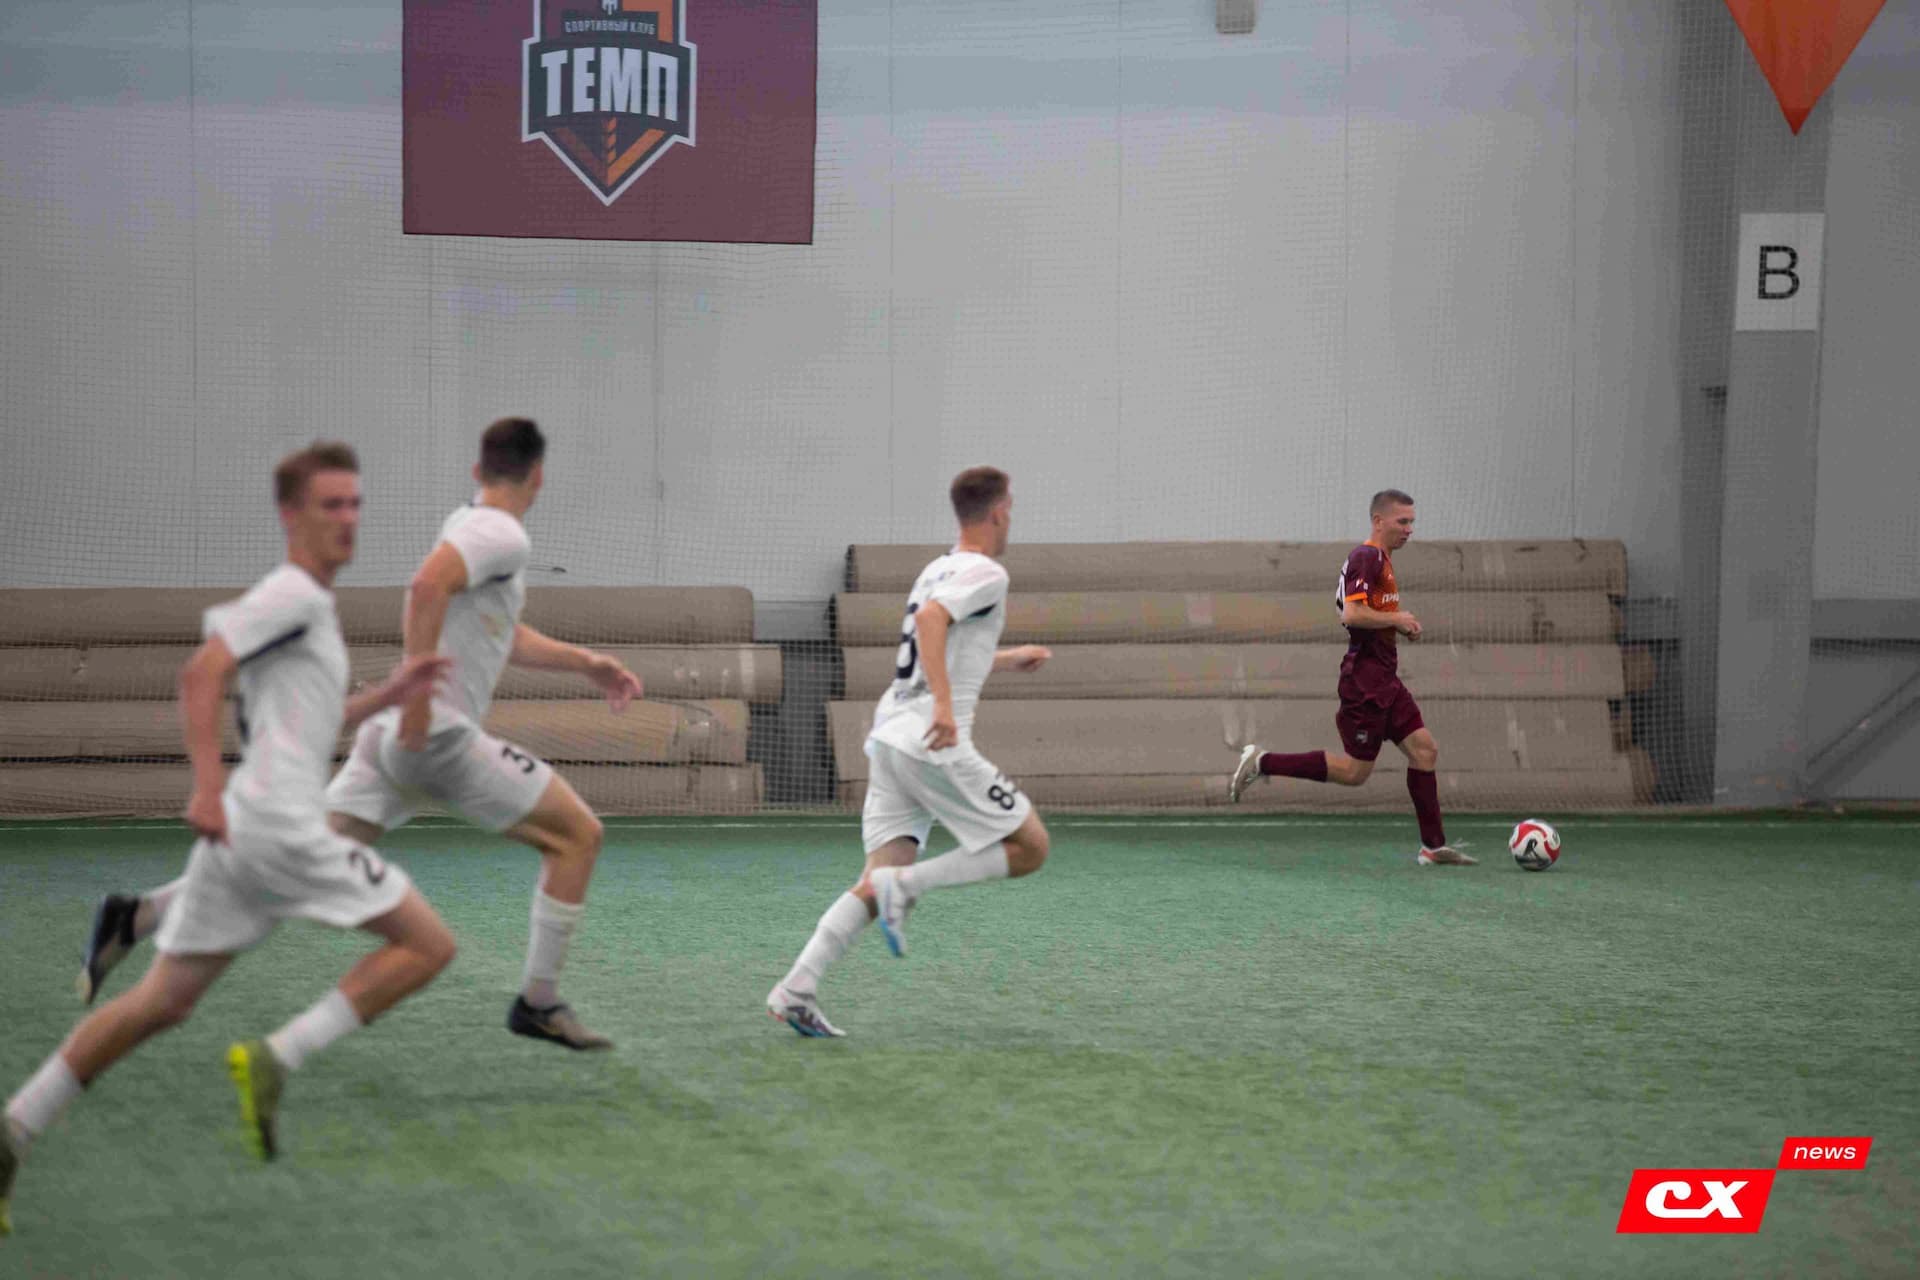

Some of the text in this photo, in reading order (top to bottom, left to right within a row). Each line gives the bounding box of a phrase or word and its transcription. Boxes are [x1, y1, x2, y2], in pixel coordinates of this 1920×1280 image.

[541, 47, 678, 121] ТЕМП
[502, 746, 535, 774] 3
[348, 850, 385, 886] 2
